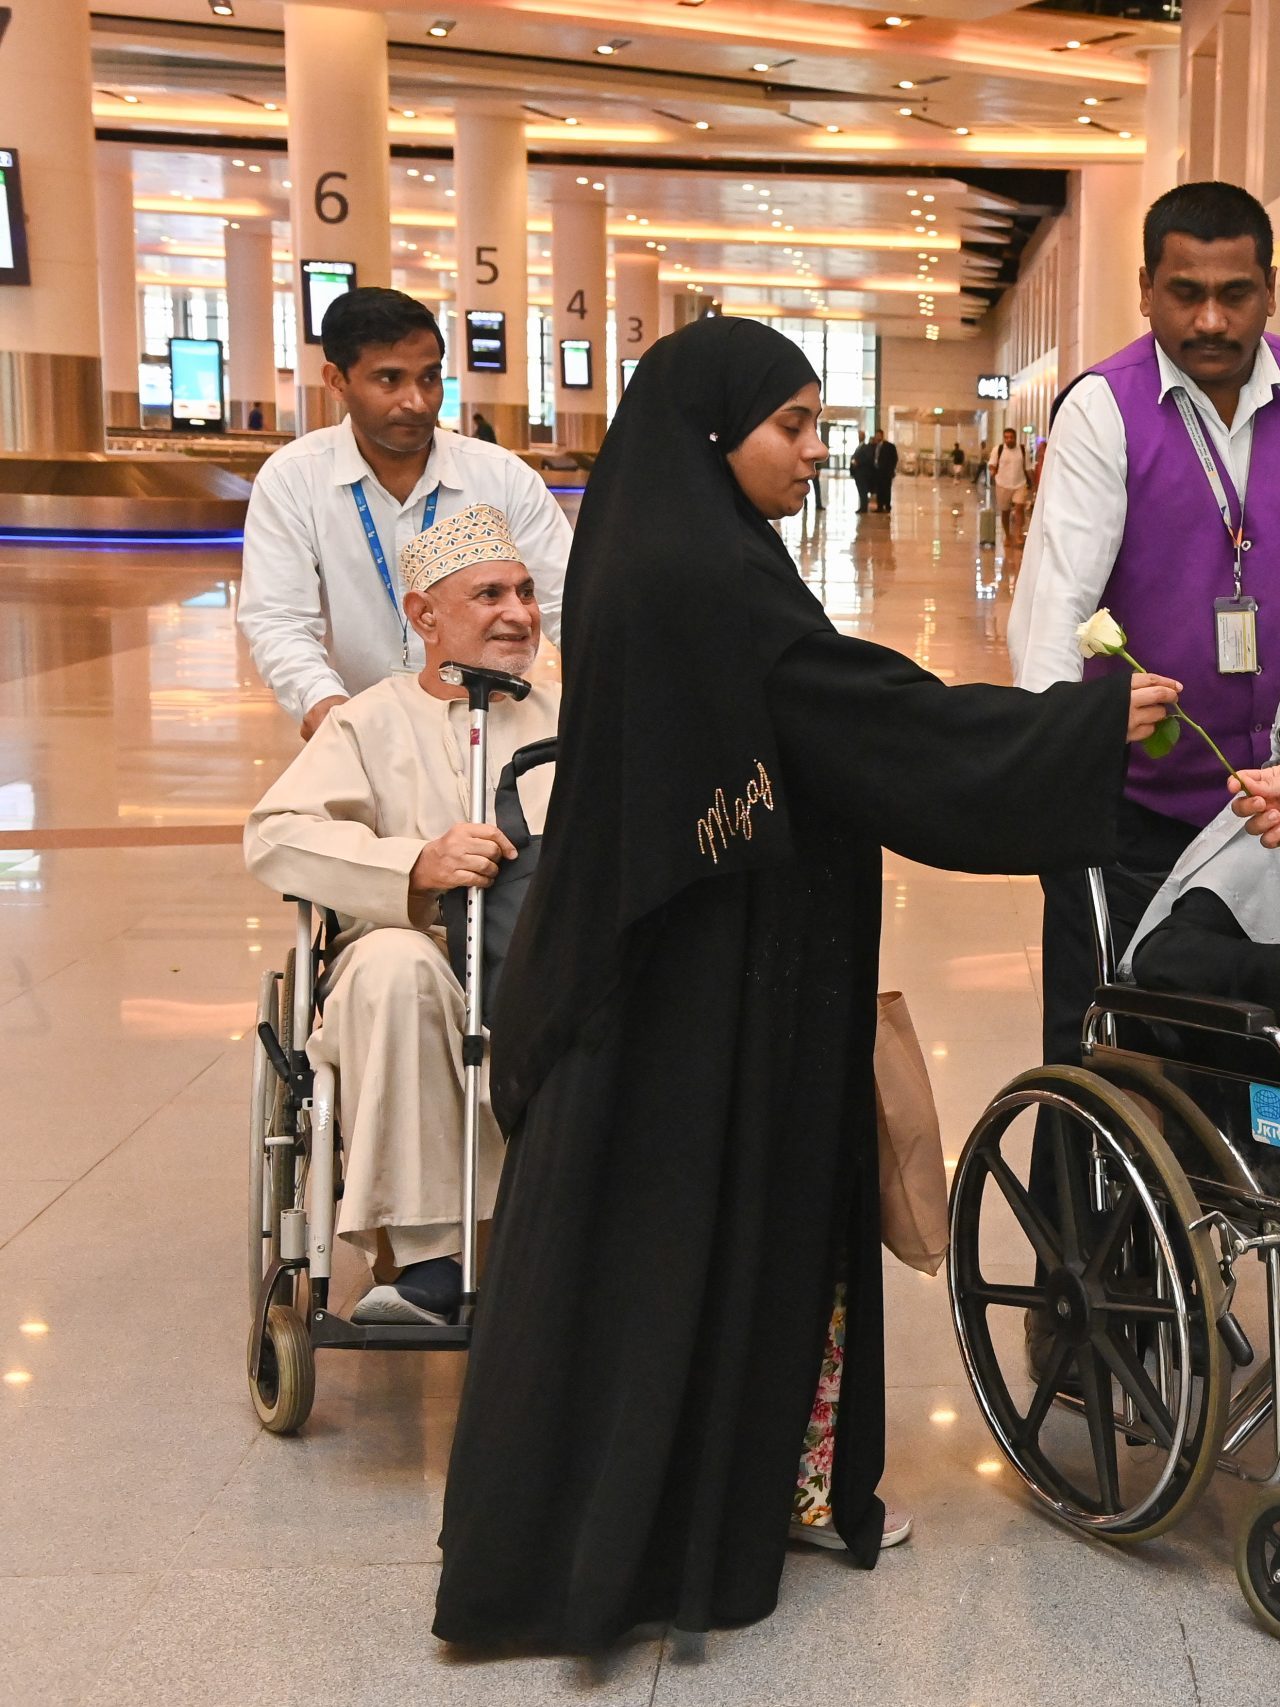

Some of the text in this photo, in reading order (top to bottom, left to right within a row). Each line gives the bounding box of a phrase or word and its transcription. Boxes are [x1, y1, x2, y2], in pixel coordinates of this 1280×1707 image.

[315, 171, 349, 225] 6
[476, 246, 499, 286] 5
[566, 290, 588, 320] 4
[627, 317, 643, 343] 3
